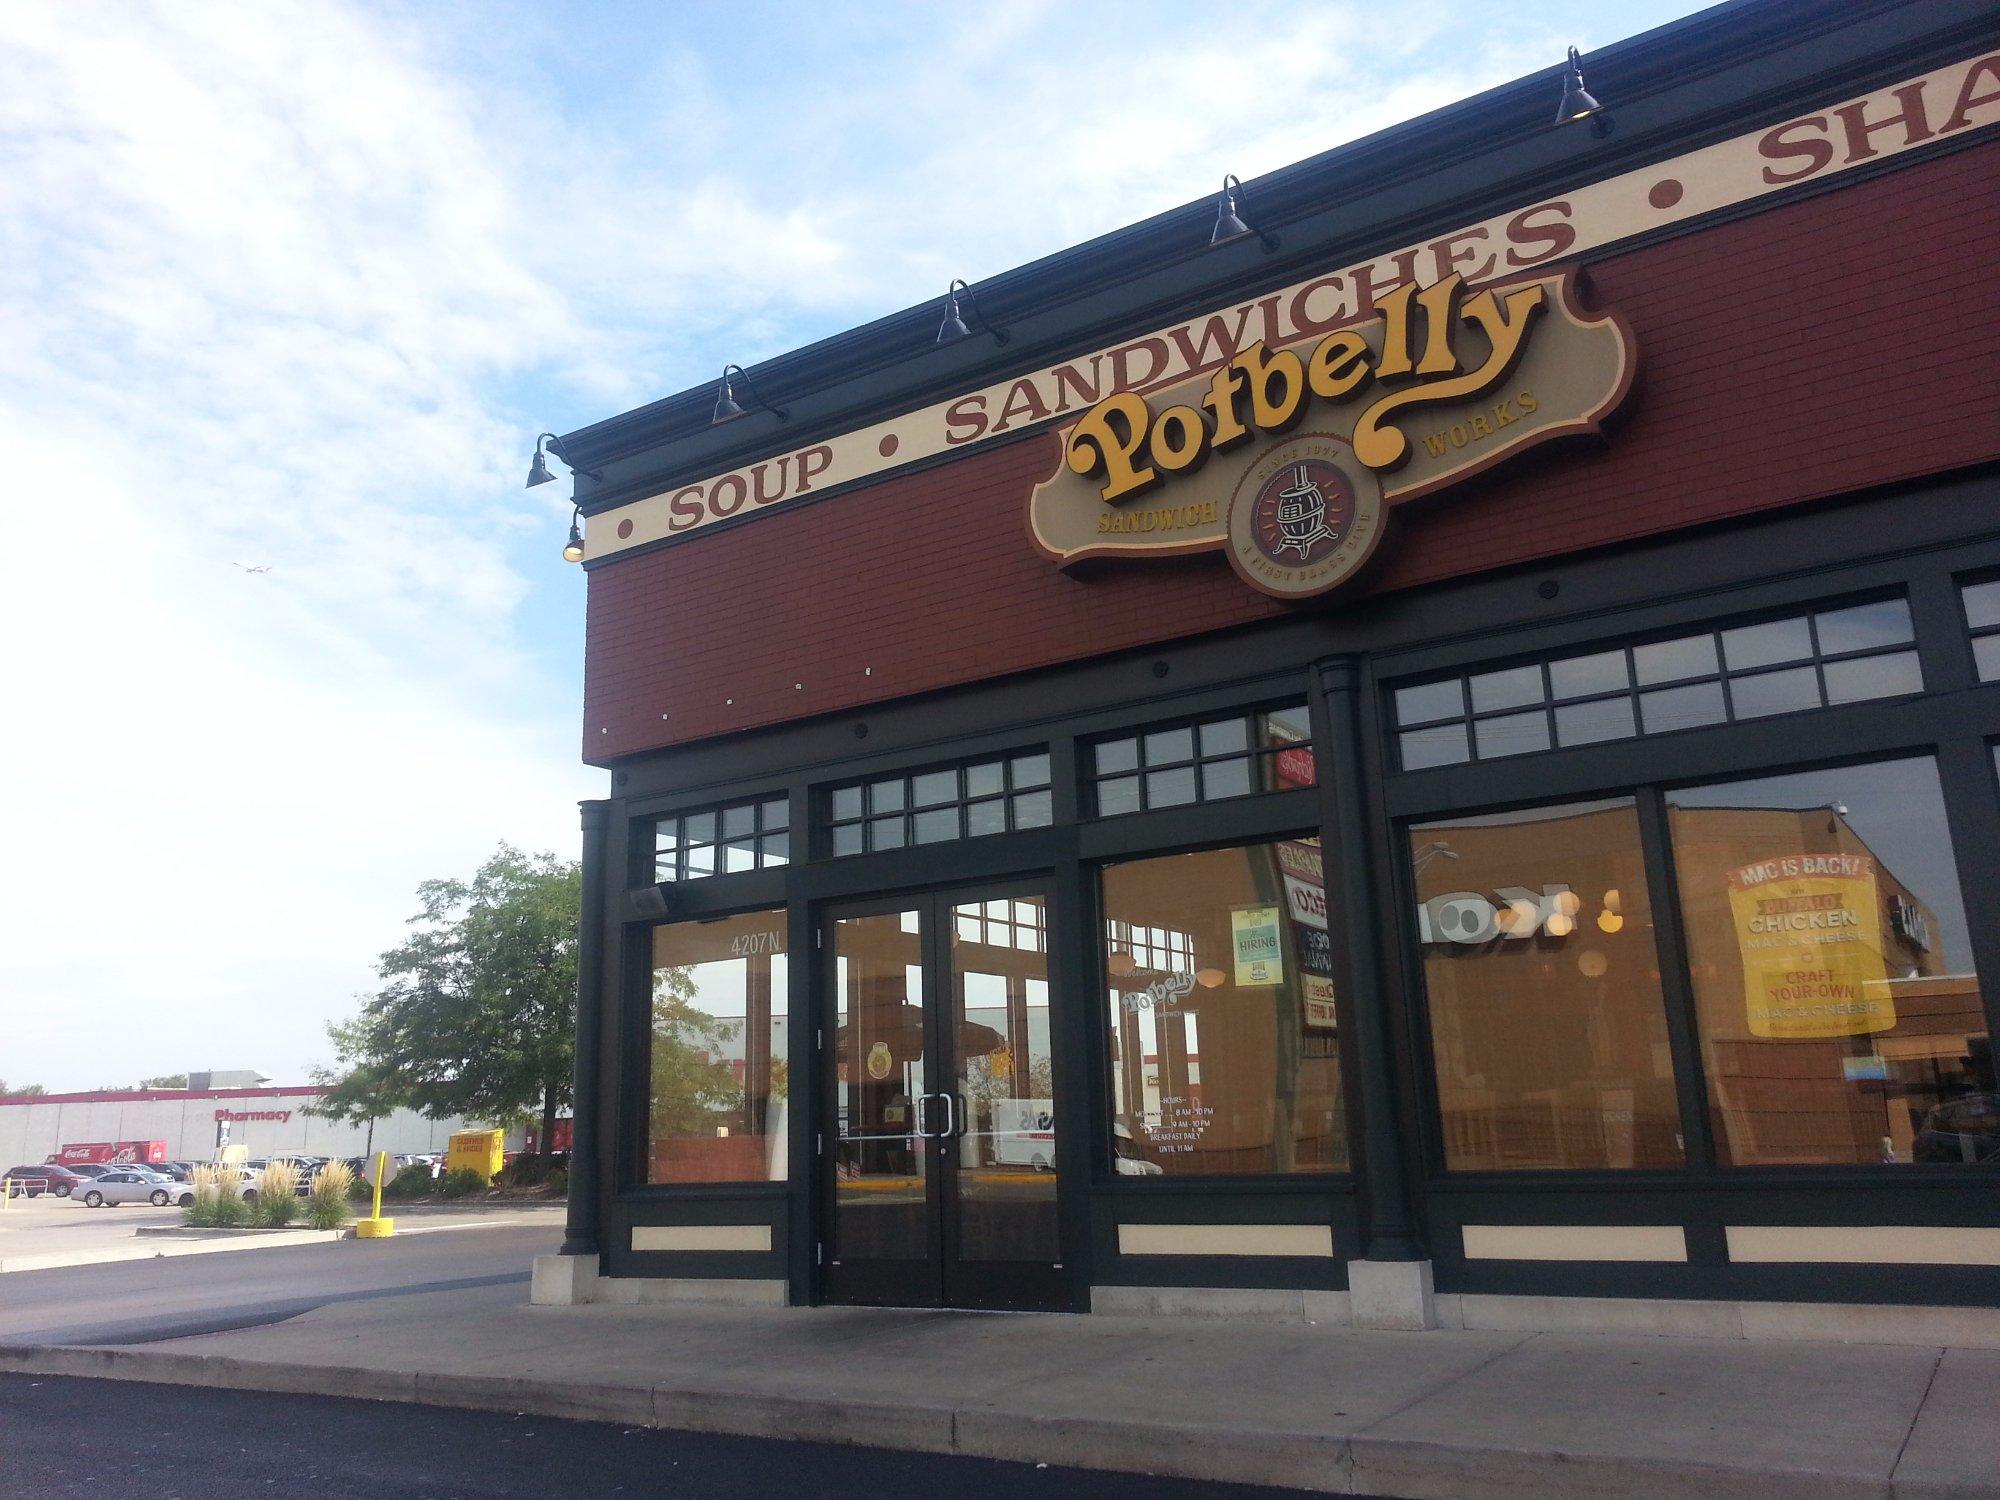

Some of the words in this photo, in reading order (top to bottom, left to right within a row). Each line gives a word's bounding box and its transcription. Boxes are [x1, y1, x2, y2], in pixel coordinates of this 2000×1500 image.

[668, 444, 833, 532] SOUP
[945, 202, 1576, 446] SANDWICHES
[1066, 270, 1546, 503] Potbelly
[1098, 501, 1218, 534] SANDWICH
[1423, 390, 1538, 458] WORKS
[1740, 862, 1778, 885] MAC
[1783, 859, 1800, 877] IS
[1803, 855, 1860, 876] BACK!
[1748, 910, 1858, 934] CHICKEN
[731, 932, 768, 956] 4207
[769, 930, 782, 951] N.
[1239, 937, 1276, 952] HIRING
[1786, 970, 1834, 984] CRAFT
[1121, 968, 1197, 1016] Potbelly
[215, 1108, 292, 1124] Pharmacy
[1203, 1107, 1214, 1116] PM
[1200, 1119, 1211, 1128] PM
[1150, 1132, 1183, 1141] BREAKFAST
[1183, 1131, 1201, 1140] DAILY
[64, 1148, 92, 1159] Coca-Cola
